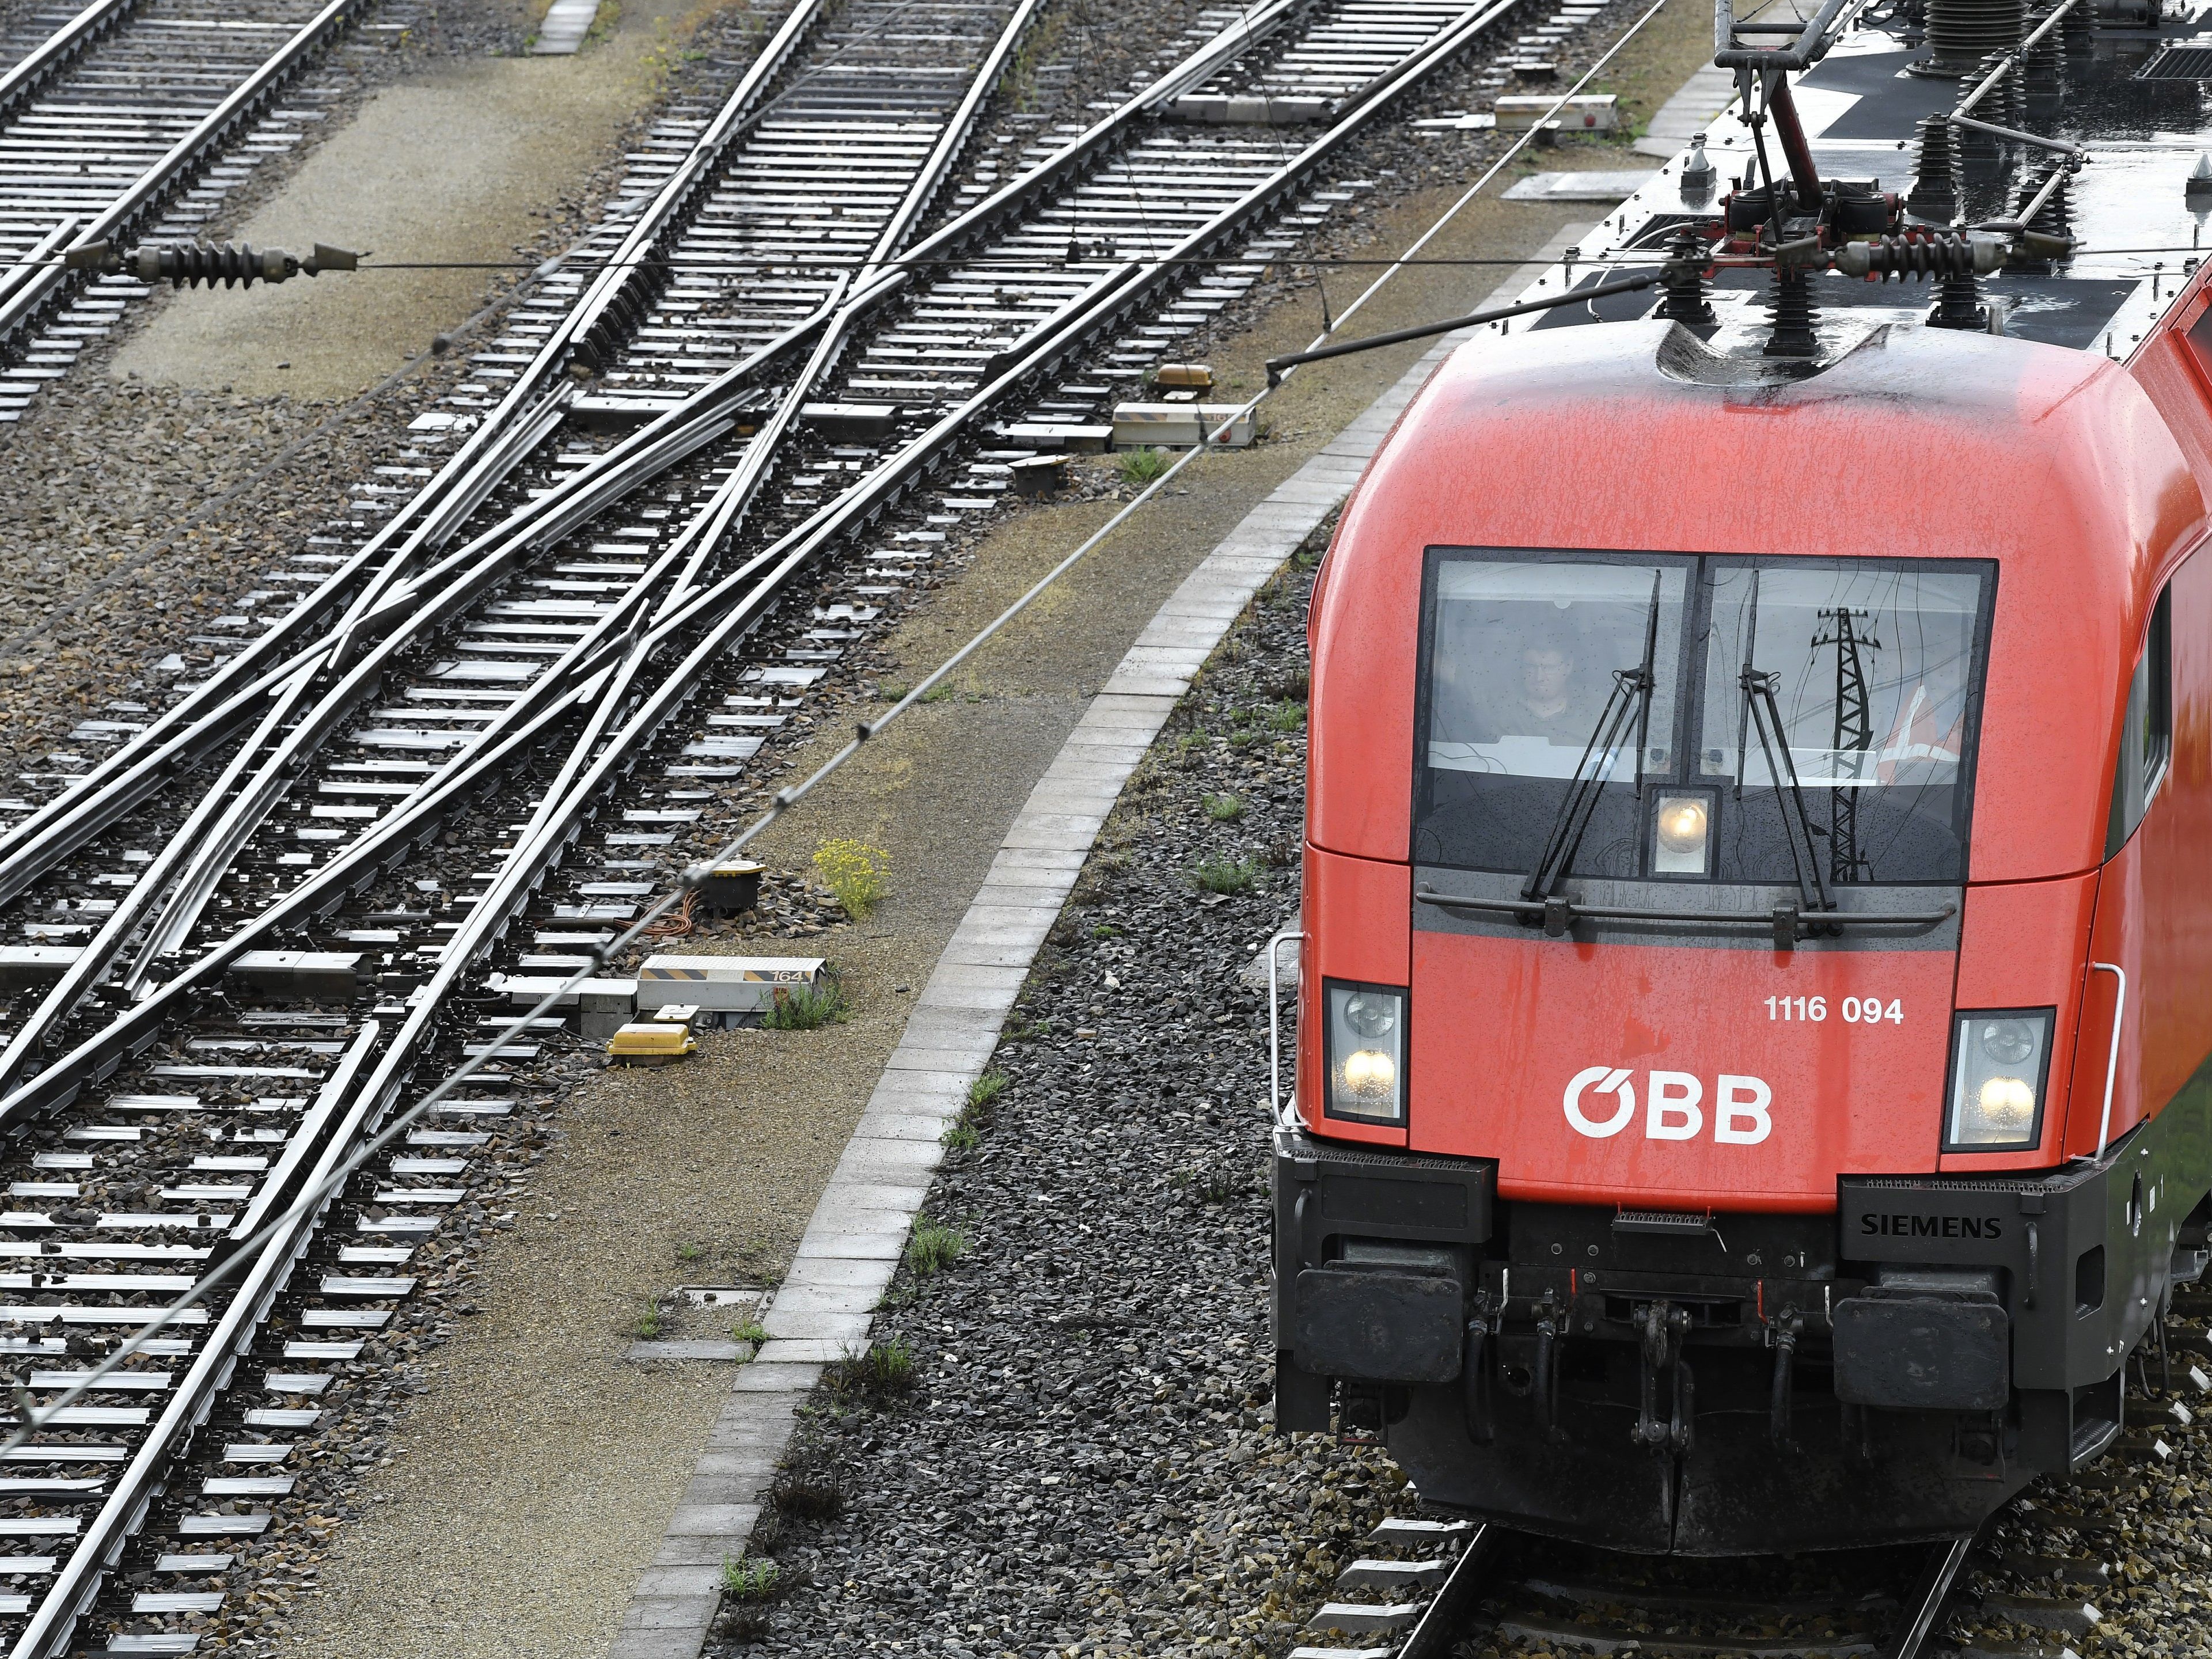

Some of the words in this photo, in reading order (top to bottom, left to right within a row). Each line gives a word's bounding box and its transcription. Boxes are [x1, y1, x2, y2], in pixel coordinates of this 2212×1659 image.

[771, 971, 804, 981] 164
[1764, 995, 1827, 1022] 1116
[1842, 996, 1904, 1024] 094
[1563, 1066, 1772, 1145] ÖBB
[1861, 1213, 2001, 1239] SIEMENS
